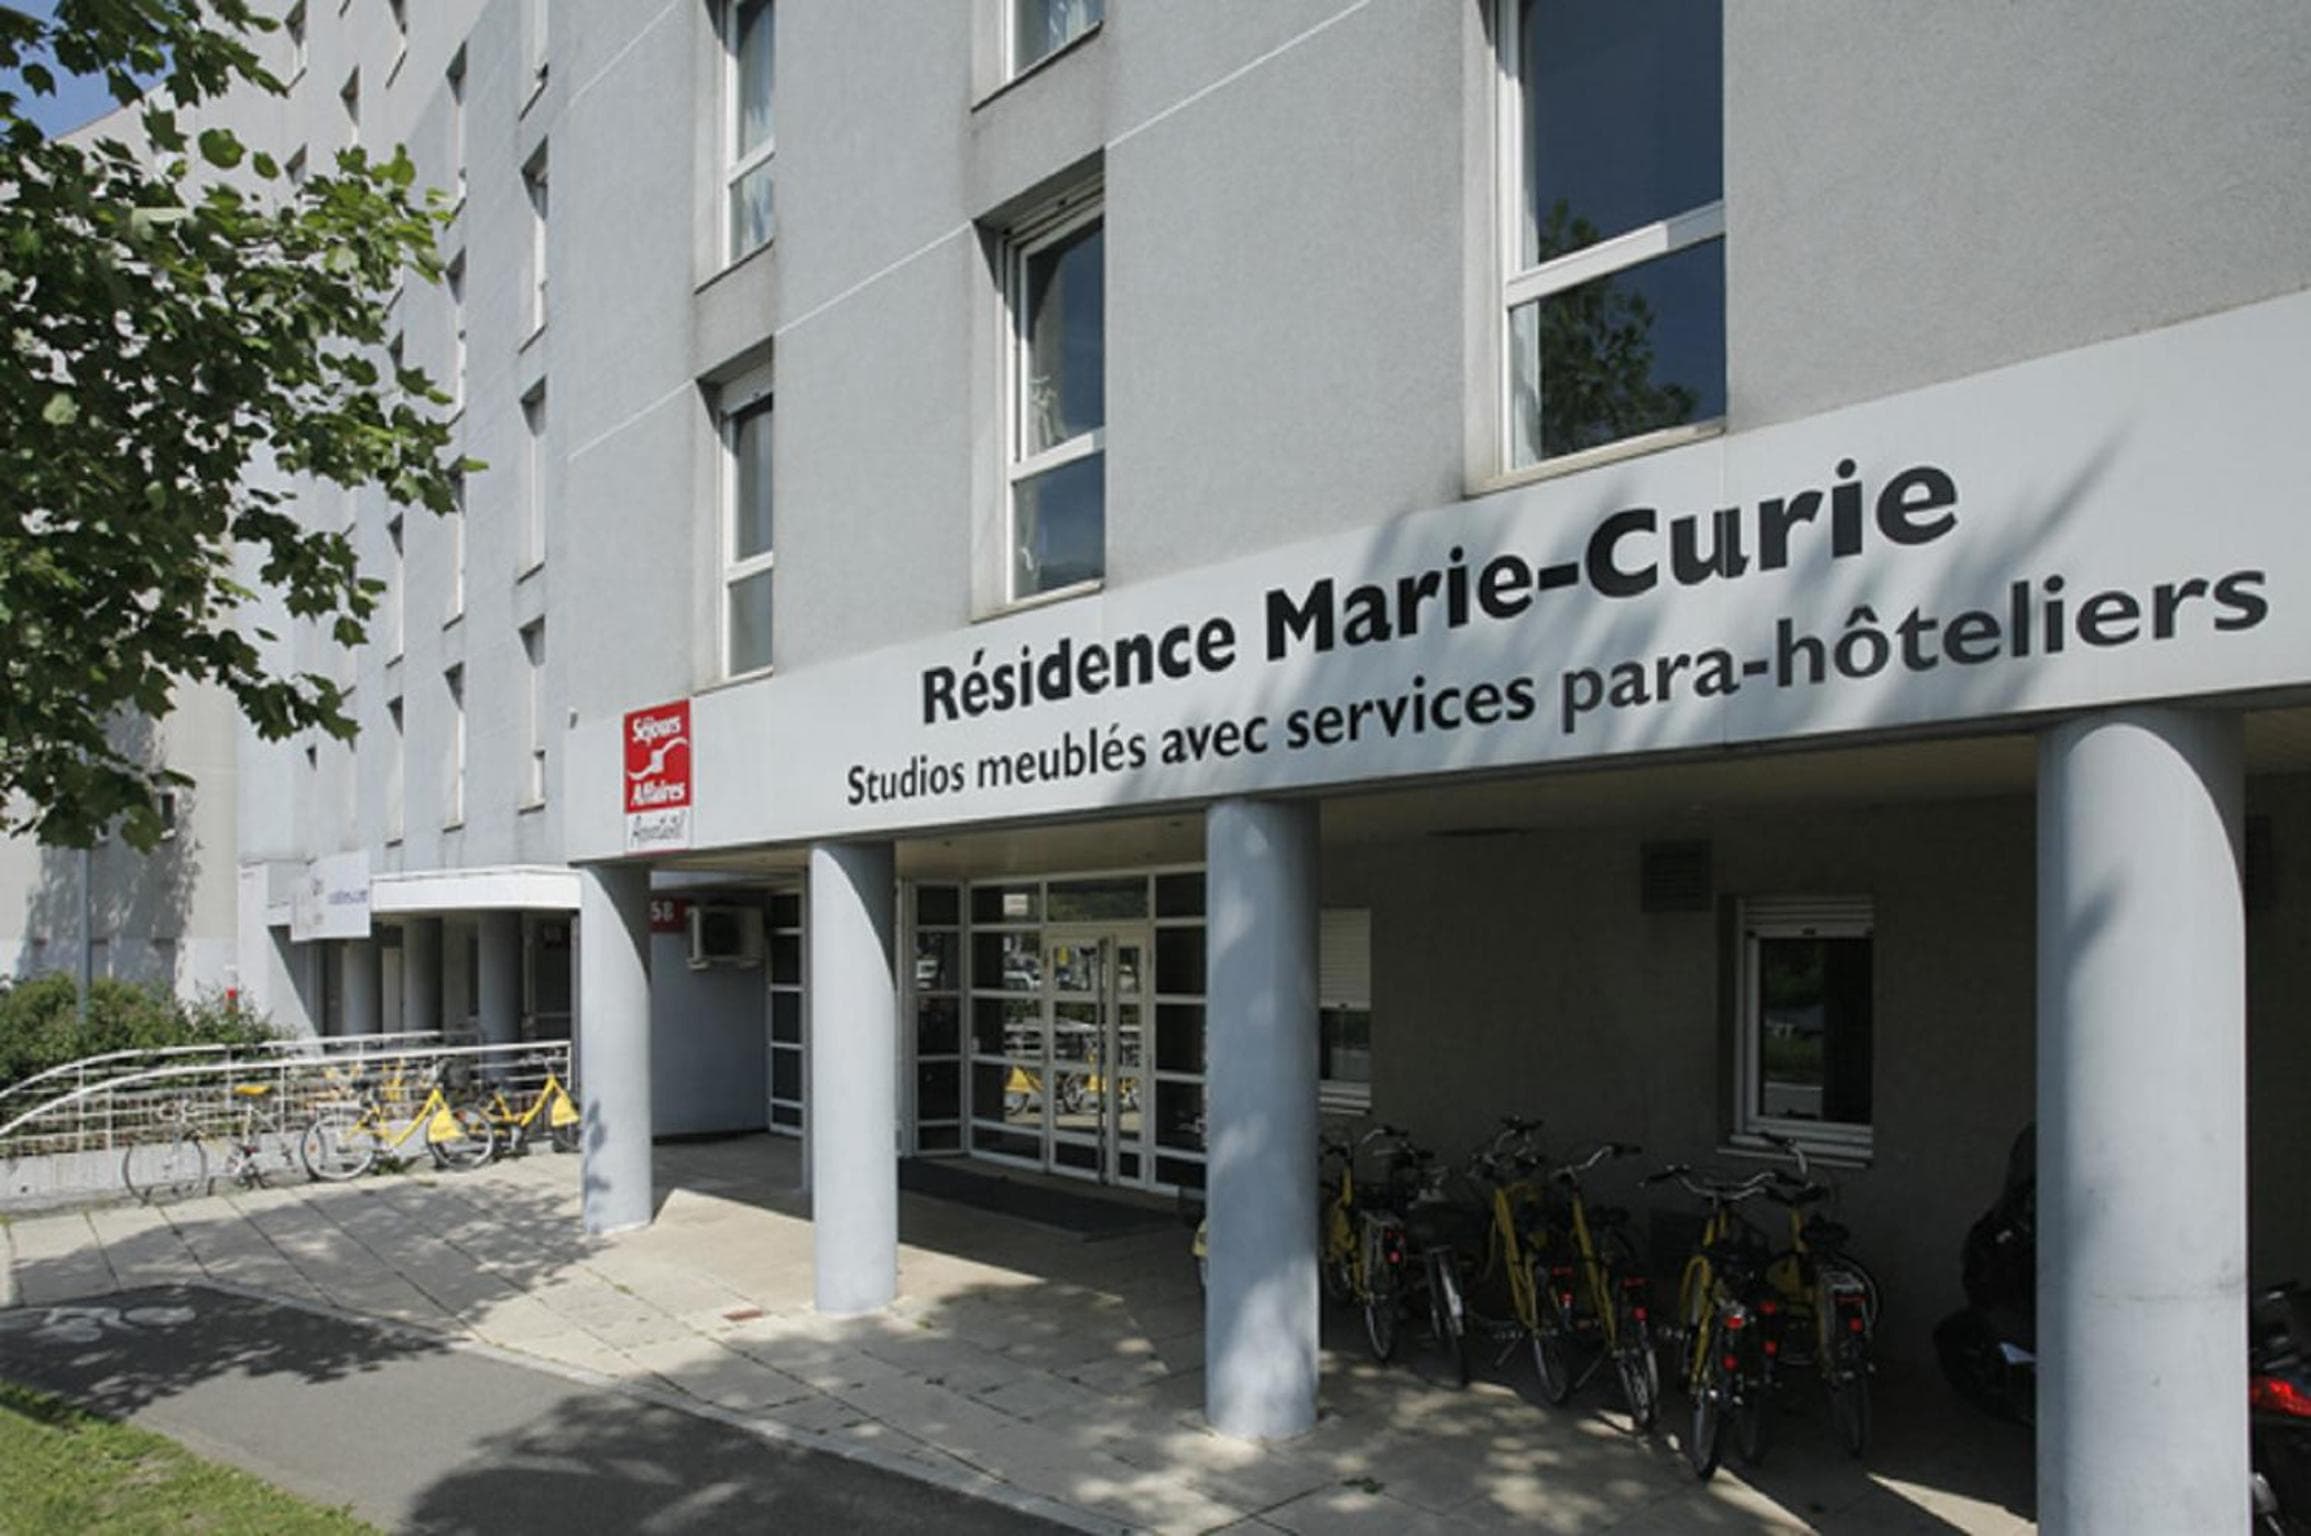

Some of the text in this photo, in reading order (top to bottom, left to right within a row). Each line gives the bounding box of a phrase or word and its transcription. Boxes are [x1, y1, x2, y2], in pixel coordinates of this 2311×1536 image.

[921, 457, 1958, 725] Résidence Marie-Curie
[631, 714, 683, 747] Séjours
[846, 569, 2271, 806] Studios meublés avec services para-hôteliers
[629, 779, 686, 807] Affaires
